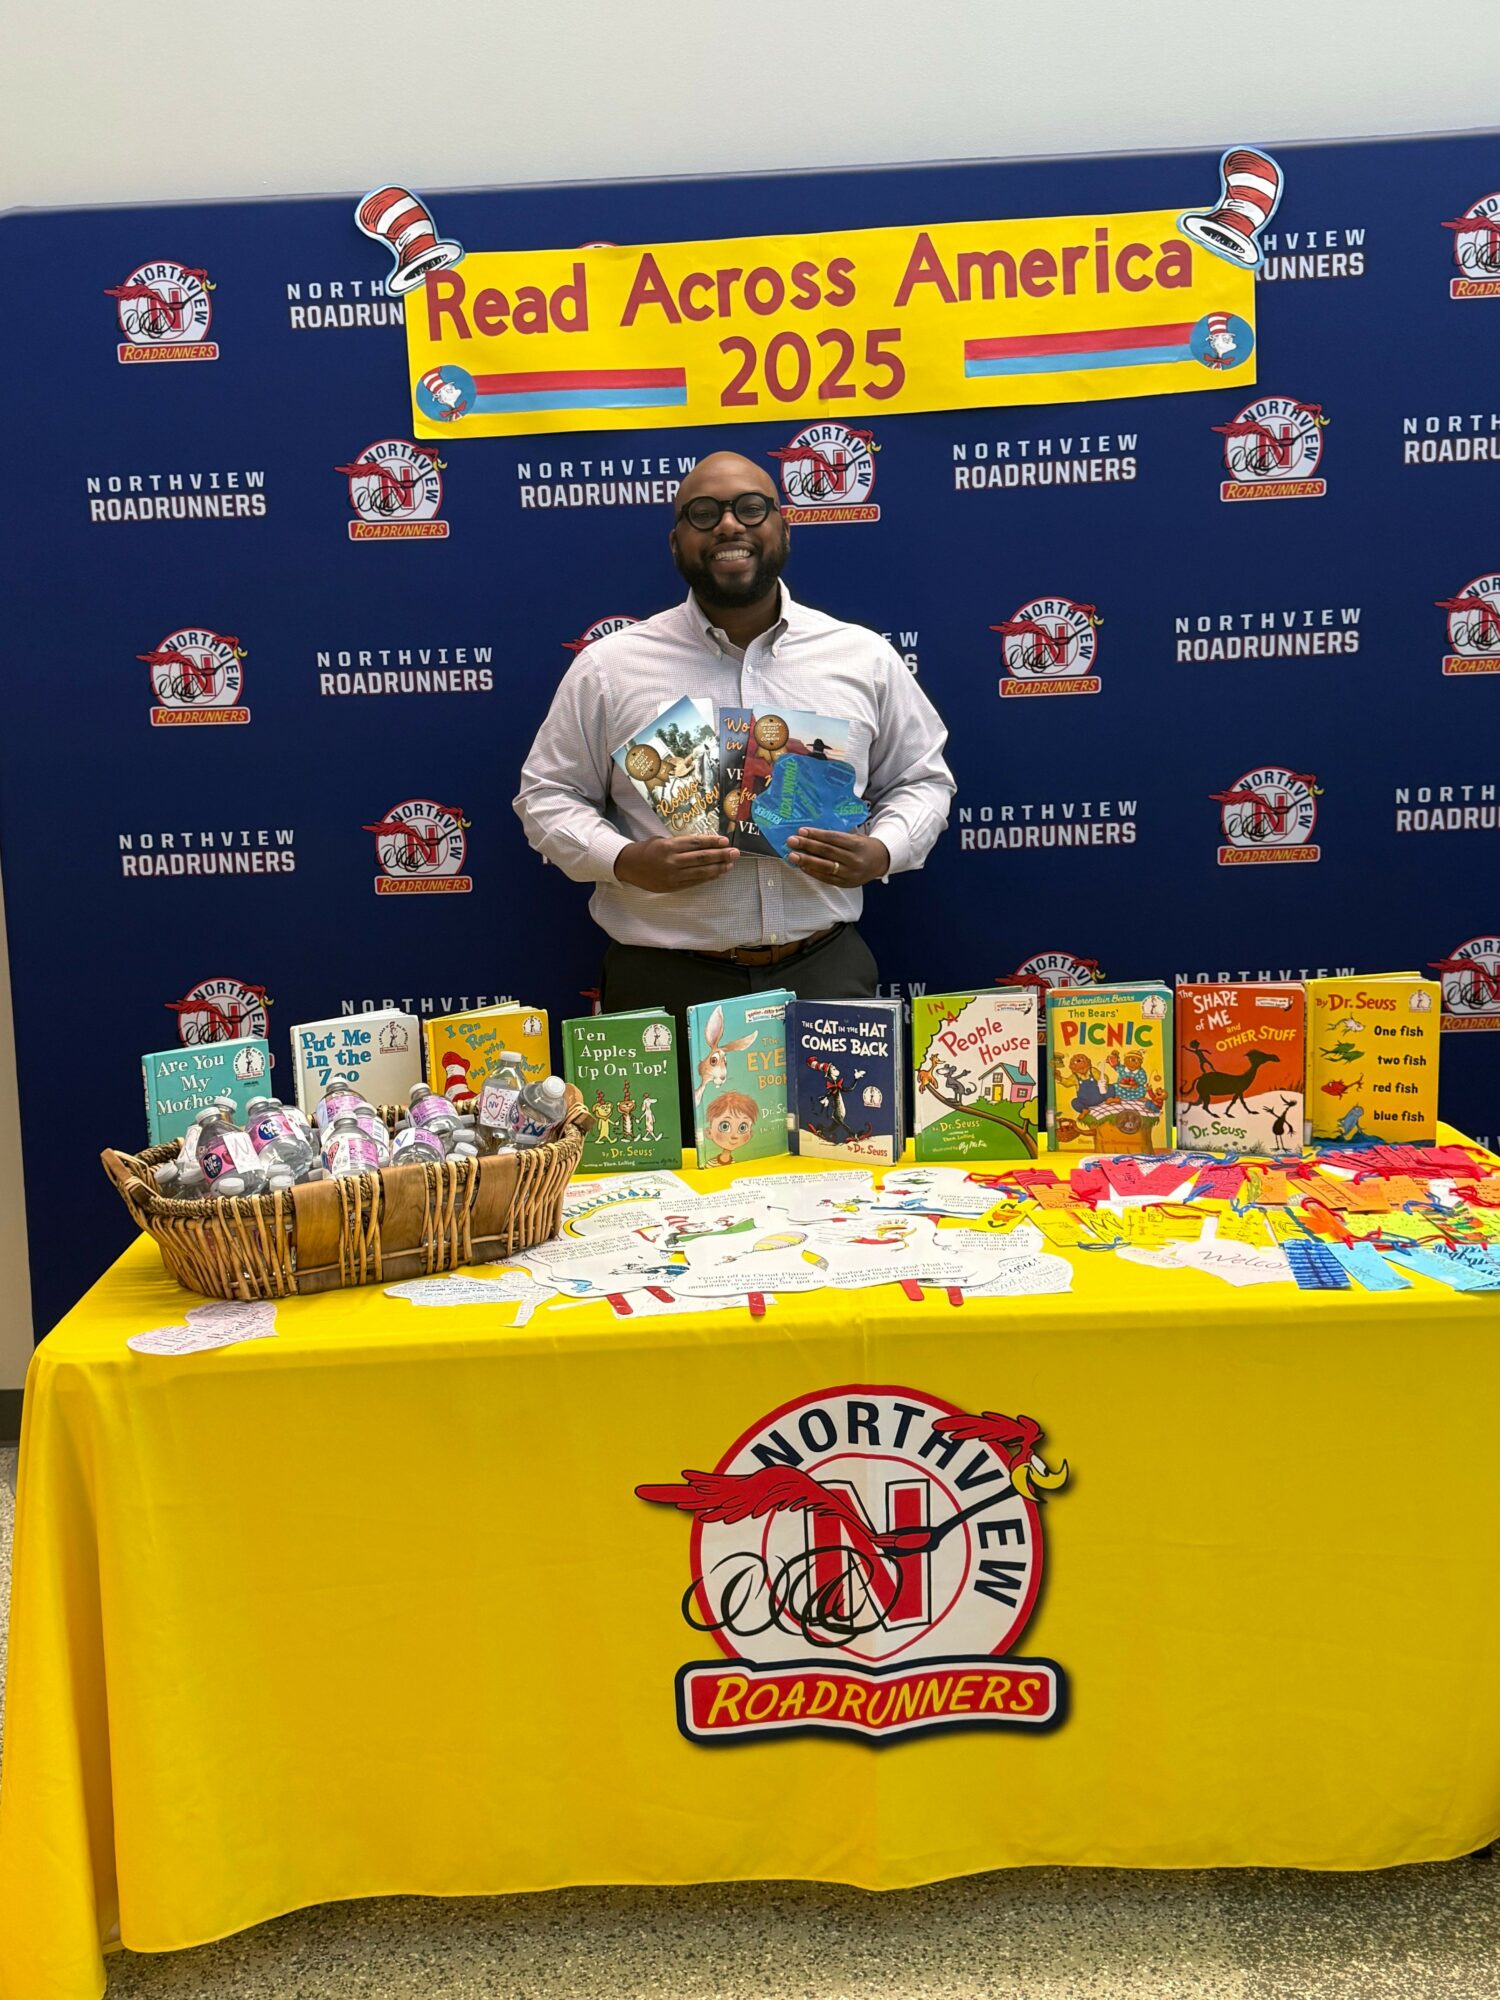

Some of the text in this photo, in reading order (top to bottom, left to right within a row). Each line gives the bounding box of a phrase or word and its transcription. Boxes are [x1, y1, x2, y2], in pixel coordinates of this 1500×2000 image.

[427, 227, 1193, 341] Read Across America
[123, 344, 215, 361] ROADRUNNERS
[719, 327, 906, 407] 2025
[953, 434, 1139, 460] NORTHVIEW
[518, 457, 696, 480] NORTHVIEW
[954, 456, 1138, 489] ROADRUNNERS
[87, 470, 266, 493] NORTHVIEW
[1225, 482, 1322, 498] ROADRUNNERS
[90, 493, 267, 522] ROADRUNNERS
[785, 507, 876, 522] ROADRUNNERS
[354, 524, 446, 538] ROADRUNNERS
[1175, 607, 1362, 634] NORTHVIEW
[1176, 630, 1360, 662] ROADRUNNERS
[317, 647, 494, 668] NORTHVIEW
[320, 667, 494, 695] ROADRUNNERS
[1005, 680, 1097, 694] ROADRUNNERS
[156, 708, 247, 723] ROADRUNNERS
[657, 778, 701, 818] Rodeo
[960, 800, 1138, 822] NORTHVIEW
[1396, 805, 1500, 832] ROADRU
[119, 829, 295, 850] NORTHVIEW
[961, 820, 1137, 850] ROADRUNNERS
[122, 849, 296, 877] ROADRUNNERS
[1223, 848, 1316, 863] ROADRUNNERS
[380, 878, 469, 893] ROADRUNNERS
[926, 1001, 945, 1015] IN
[1057, 994, 1135, 1006] The Berenstain Bears
[1178, 989, 1193, 999] The
[1193, 991, 1238, 1014] SHAPE
[1315, 992, 1397, 1011] By Dr. Seuss
[945, 1011, 958, 1026] A
[1068, 1009, 1119, 1018] The Bears'
[1195, 1011, 1241, 1034] of ME and
[445, 1023, 481, 1039] I Can
[574, 1027, 606, 1041] Ten
[802, 1020, 815, 1030] THE
[814, 1018, 838, 1035] CAT
[847, 1026, 858, 1034] THE
[859, 1022, 888, 1038] HAT
[938, 1017, 1004, 1058] People
[1060, 1020, 1153, 1048] PICNIC
[1374, 1025, 1424, 1037] One fish
[300, 1031, 335, 1052] Put
[341, 1029, 371, 1046] Me
[466, 1028, 497, 1050] Read
[801, 1034, 888, 1058] COMES BACK
[1215, 1026, 1297, 1052] OTHER STUFF
[306, 1049, 371, 1069] in the
[580, 1045, 637, 1062] Apples
[747, 1047, 785, 1073] EYE
[978, 1035, 1032, 1066] House
[1377, 1053, 1427, 1066] two fish
[157, 1059, 188, 1078] Are
[193, 1053, 224, 1070] You
[578, 1059, 668, 1081] Up On Top!
[181, 1074, 210, 1092] My
[1373, 1081, 1419, 1094] red fish
[940, 1122, 954, 1131] Dr.
[1373, 1109, 1425, 1123] blue fish
[1187, 1124, 1209, 1139] Dr.
[1211, 1121, 1248, 1139] Seuss
[611, 1147, 625, 1158] Dr.
[854, 1143, 866, 1153] Dr.
[867, 1144, 888, 1157] Seuss
[707, 1674, 1041, 1726] ROADRUNNERS
